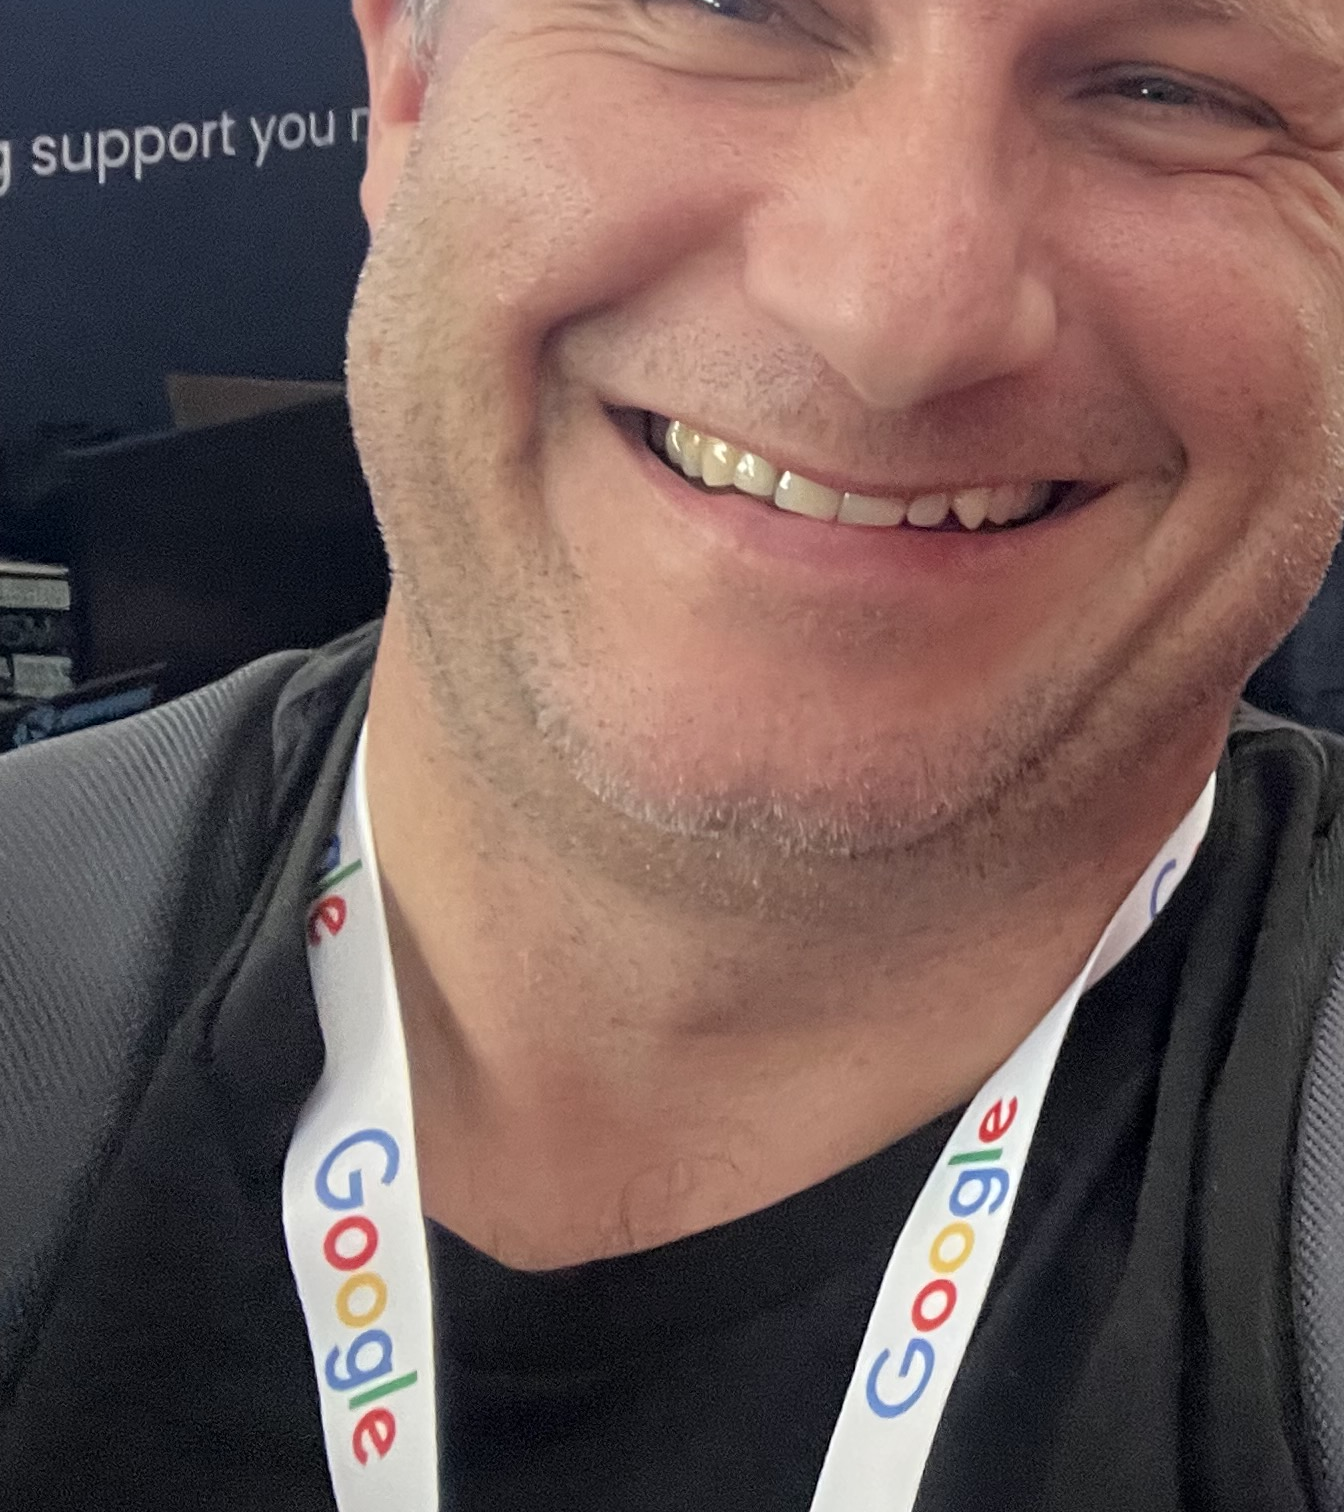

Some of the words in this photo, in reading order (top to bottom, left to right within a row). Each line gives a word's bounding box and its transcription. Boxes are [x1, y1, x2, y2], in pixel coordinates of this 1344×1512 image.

[32, 110, 237, 185] support
[249, 110, 336, 169] you
[314, 1127, 418, 1467] Google
[865, 1095, 1019, 1419] Google
